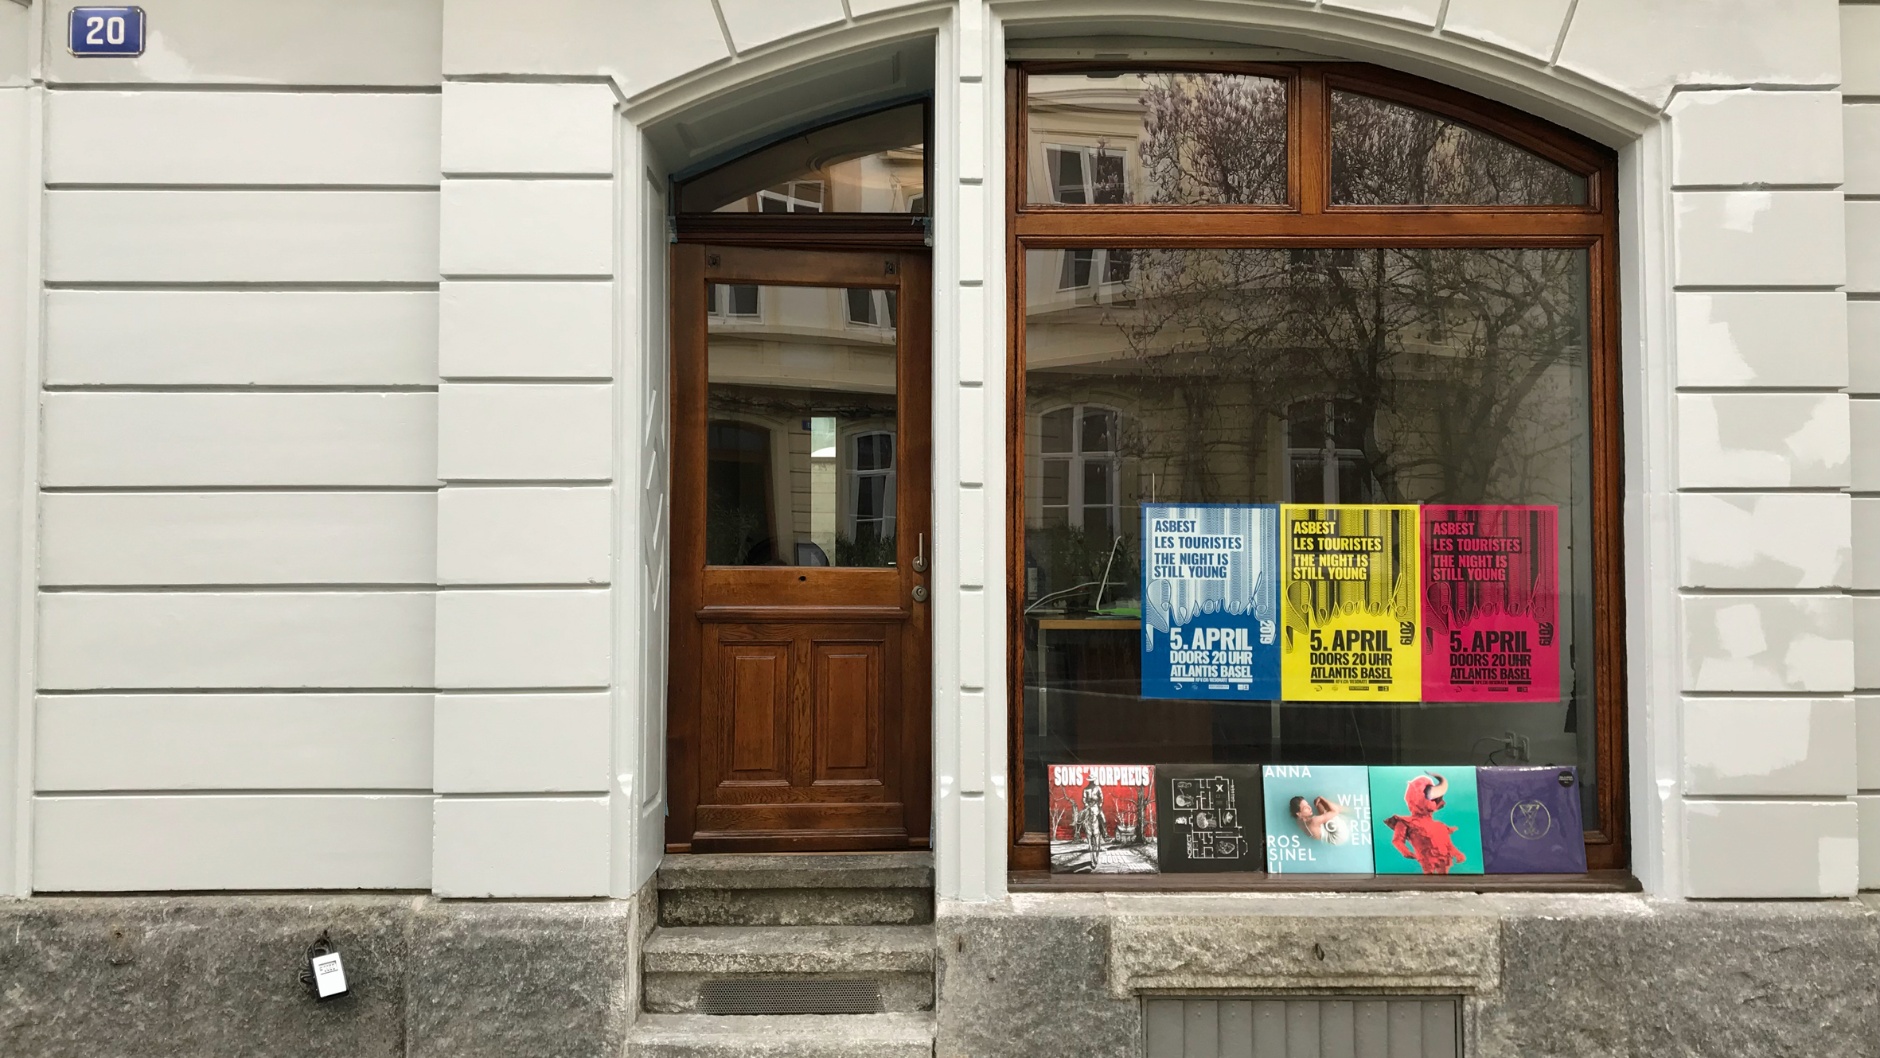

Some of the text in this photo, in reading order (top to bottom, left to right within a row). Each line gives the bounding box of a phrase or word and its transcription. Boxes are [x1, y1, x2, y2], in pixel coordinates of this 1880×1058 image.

[86, 16, 124, 44] 20
[1155, 520, 1196, 532] ASBEST
[1294, 522, 1336, 534] ASBEST
[1433, 523, 1475, 535] ASBEST
[1155, 537, 1242, 549] LES TOURISTES
[1294, 538, 1381, 551] LES TOURISTES
[1434, 539, 1520, 552] LES TOURISTES
[1154, 553, 1229, 565] THE NIGHT IS
[1294, 554, 1368, 567] THE NIGHT IS
[1433, 555, 1507, 567] THE NIGHT IS
[1154, 566, 1227, 578] STILL YOUNG
[1294, 567, 1366, 580] STILL YOUNG
[1433, 568, 1506, 581] STILL YOUNG
[1170, 628, 1253, 650] 5. APRIL
[1260, 621, 1271, 644] 2019
[1400, 622, 1412, 645] 2019
[1539, 622, 1551, 646] 2019
[1310, 630, 1392, 651] 5. APRIL
[1450, 631, 1531, 652] 5. APRIL
[1170, 651, 1252, 665] DOORS 20 UHR
[1310, 653, 1392, 666] DOORS 20 UHR
[1450, 654, 1531, 666] DOORS 20 UHR
[1171, 665, 1253, 677] ATLANTIS BASEL
[1311, 667, 1392, 679] ATLANTIS BASEL
[1450, 668, 1531, 680] ATLANTIS BASEL
[1054, 766, 1083, 786] SONS
[1090, 766, 1149, 786] MORPHEUS
[1265, 766, 1311, 777] ANNA
[1337, 794, 1369, 806] WHI
[1354, 807, 1370, 820] TE
[1267, 835, 1300, 847] ROS
[1352, 834, 1371, 845] EN
[1270, 848, 1316, 860] SINEL
[1270, 861, 1282, 874] LI
